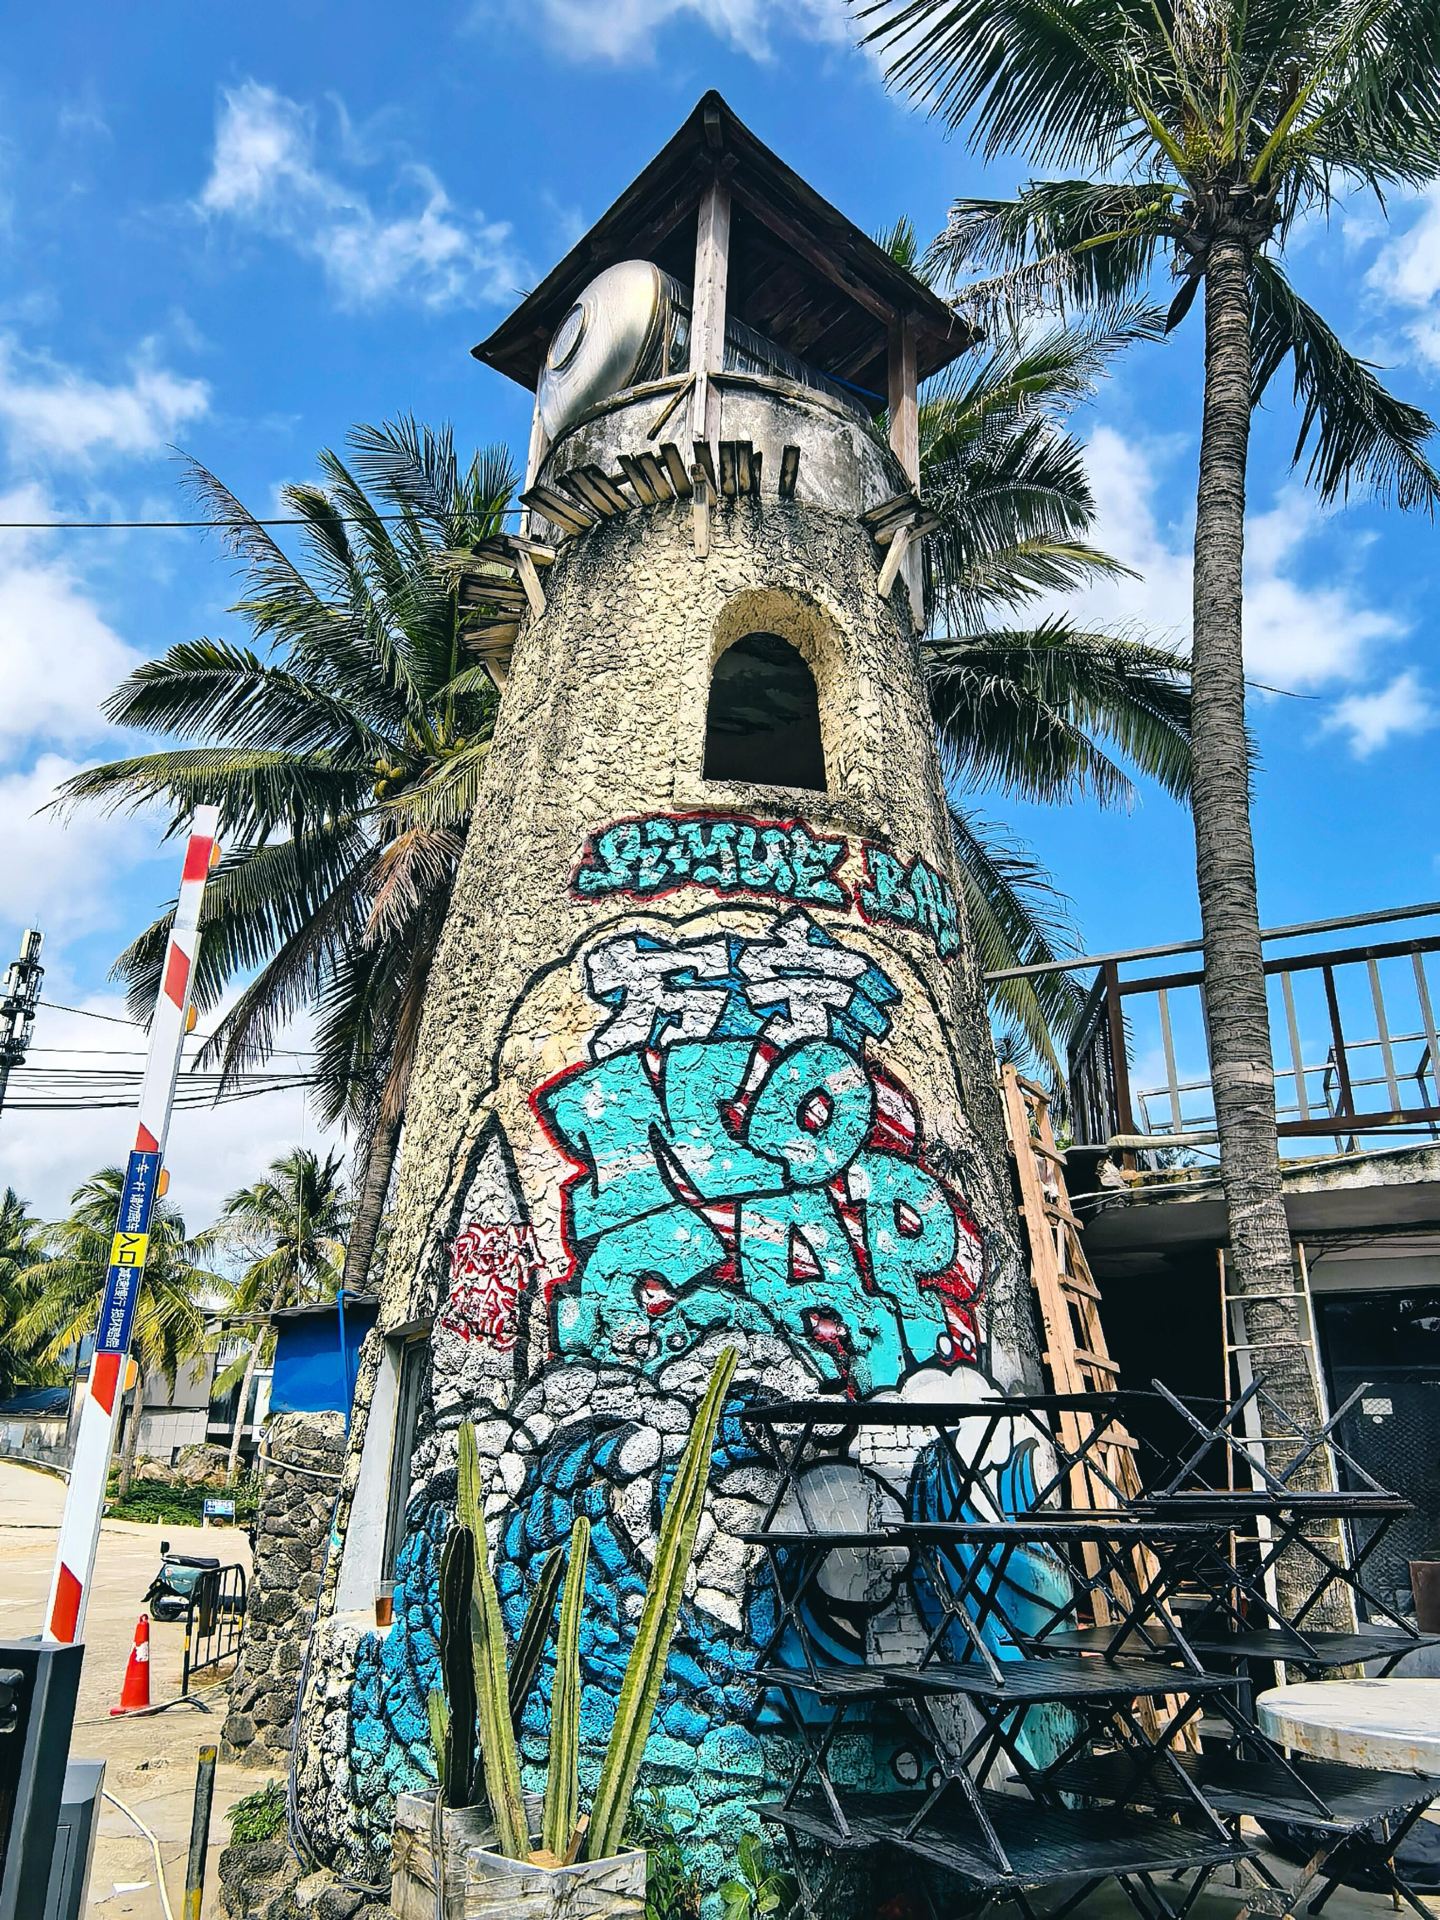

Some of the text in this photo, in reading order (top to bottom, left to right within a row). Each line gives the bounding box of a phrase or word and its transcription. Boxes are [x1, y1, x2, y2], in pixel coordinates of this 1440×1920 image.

[125, 1154, 150, 1233] 一车一杆 请勿跟车
[118, 1233, 141, 1264] 入口
[113, 1267, 133, 1309] 减速慢行
